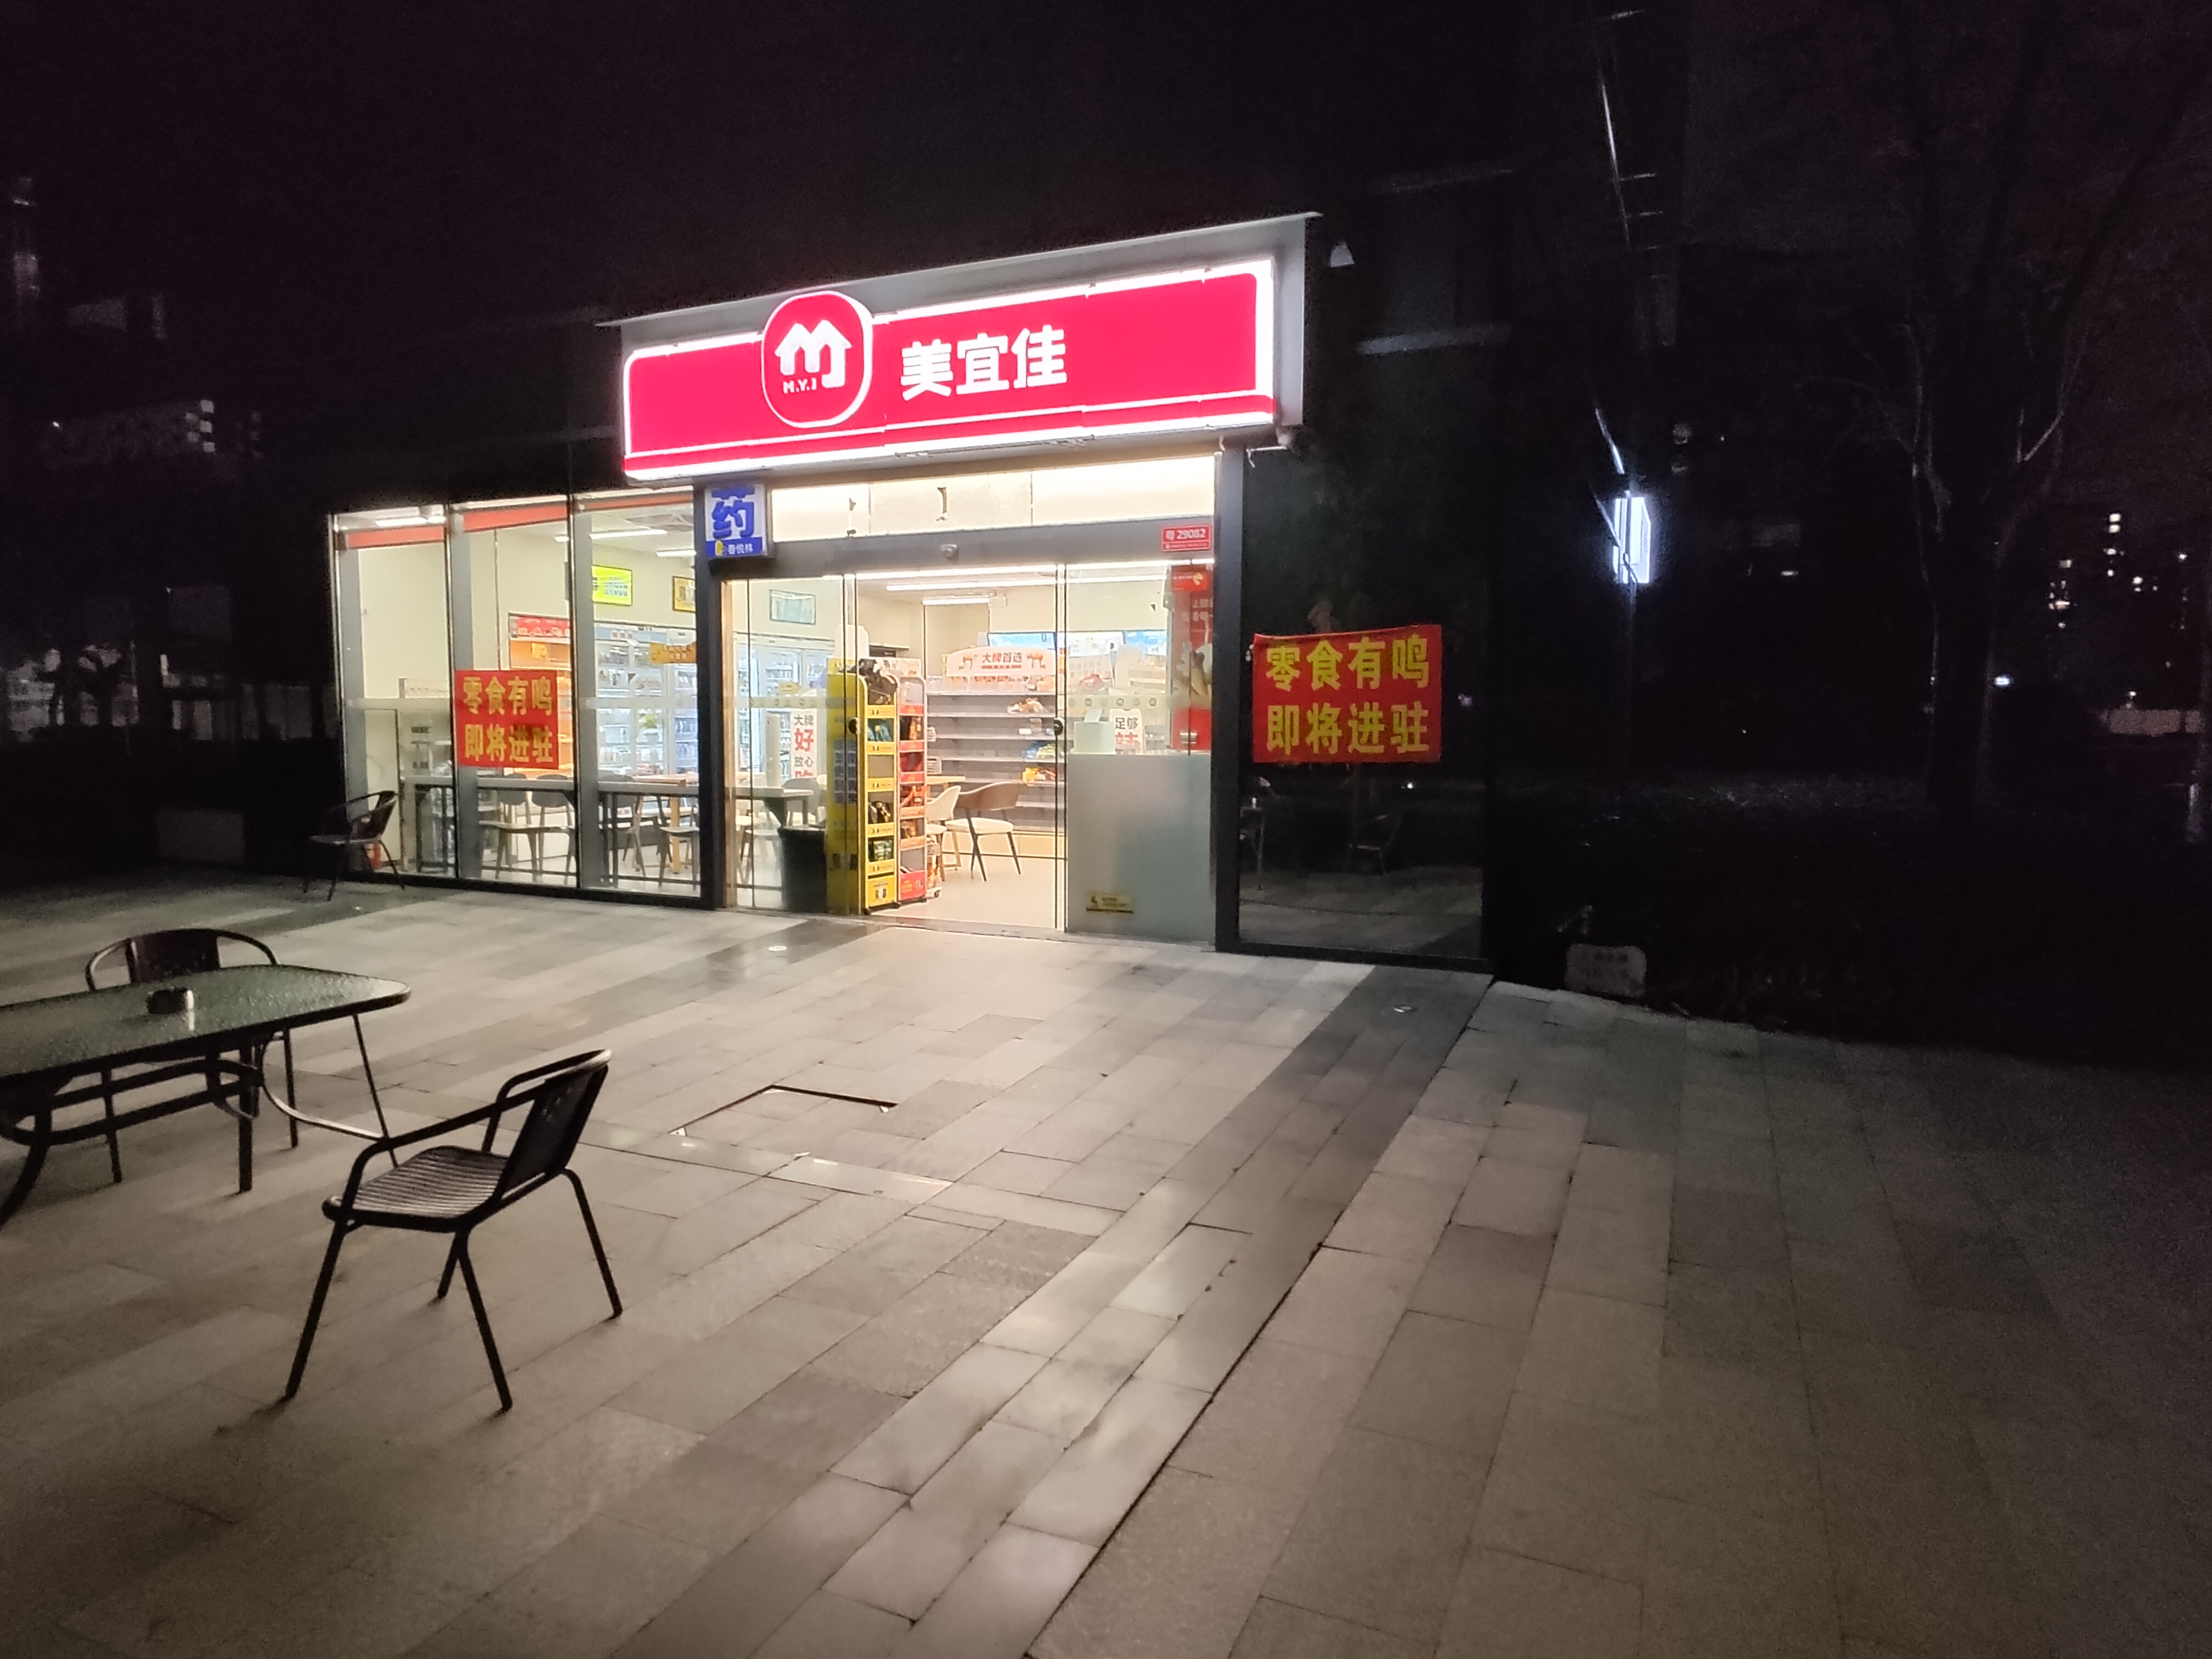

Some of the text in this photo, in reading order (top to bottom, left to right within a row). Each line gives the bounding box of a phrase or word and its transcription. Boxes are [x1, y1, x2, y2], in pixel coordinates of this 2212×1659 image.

[900, 323, 1067, 402] 美宜佳
[1177, 528, 1206, 540] 29082
[982, 651, 1023, 663] 大牌首选
[1265, 633, 1430, 692] 零食有鸣
[462, 675, 553, 716] 零食有鸣
[794, 714, 814, 726] 大牌
[1115, 717, 1138, 730] 足够
[1266, 700, 1430, 755] 即将进驻
[463, 724, 554, 764] 即将进驻
[794, 727, 814, 752] 好
[794, 756, 814, 768] 放心
